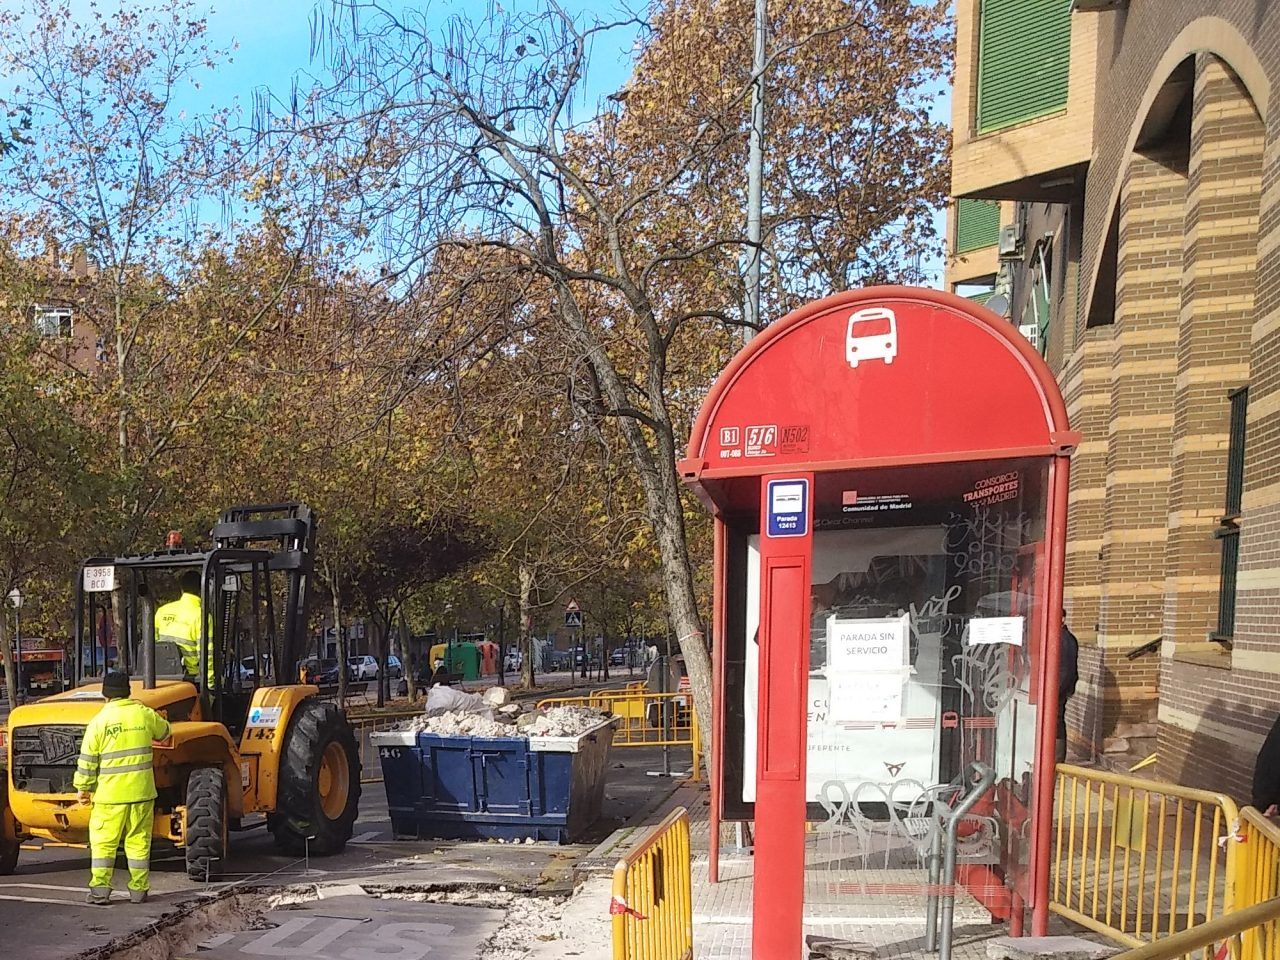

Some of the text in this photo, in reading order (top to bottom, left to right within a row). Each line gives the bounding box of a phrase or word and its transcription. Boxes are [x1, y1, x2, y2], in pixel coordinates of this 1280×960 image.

[723, 429, 736, 443] B1
[748, 427, 775, 446] 516
[781, 426, 808, 444] N502
[974, 470, 1019, 490] CONSORCIO
[962, 480, 1019, 503] TRANSPORTES
[987, 490, 1018, 505] MADRID
[842, 504, 879, 512] Comunidad
[889, 502, 912, 510] Madrid
[93, 568, 112, 578] 3958
[840, 632, 895, 641] PARADA SIN
[846, 646, 888, 655] SERVICIO
[247, 728, 276, 740] 143
[380, 747, 401, 759] 46
